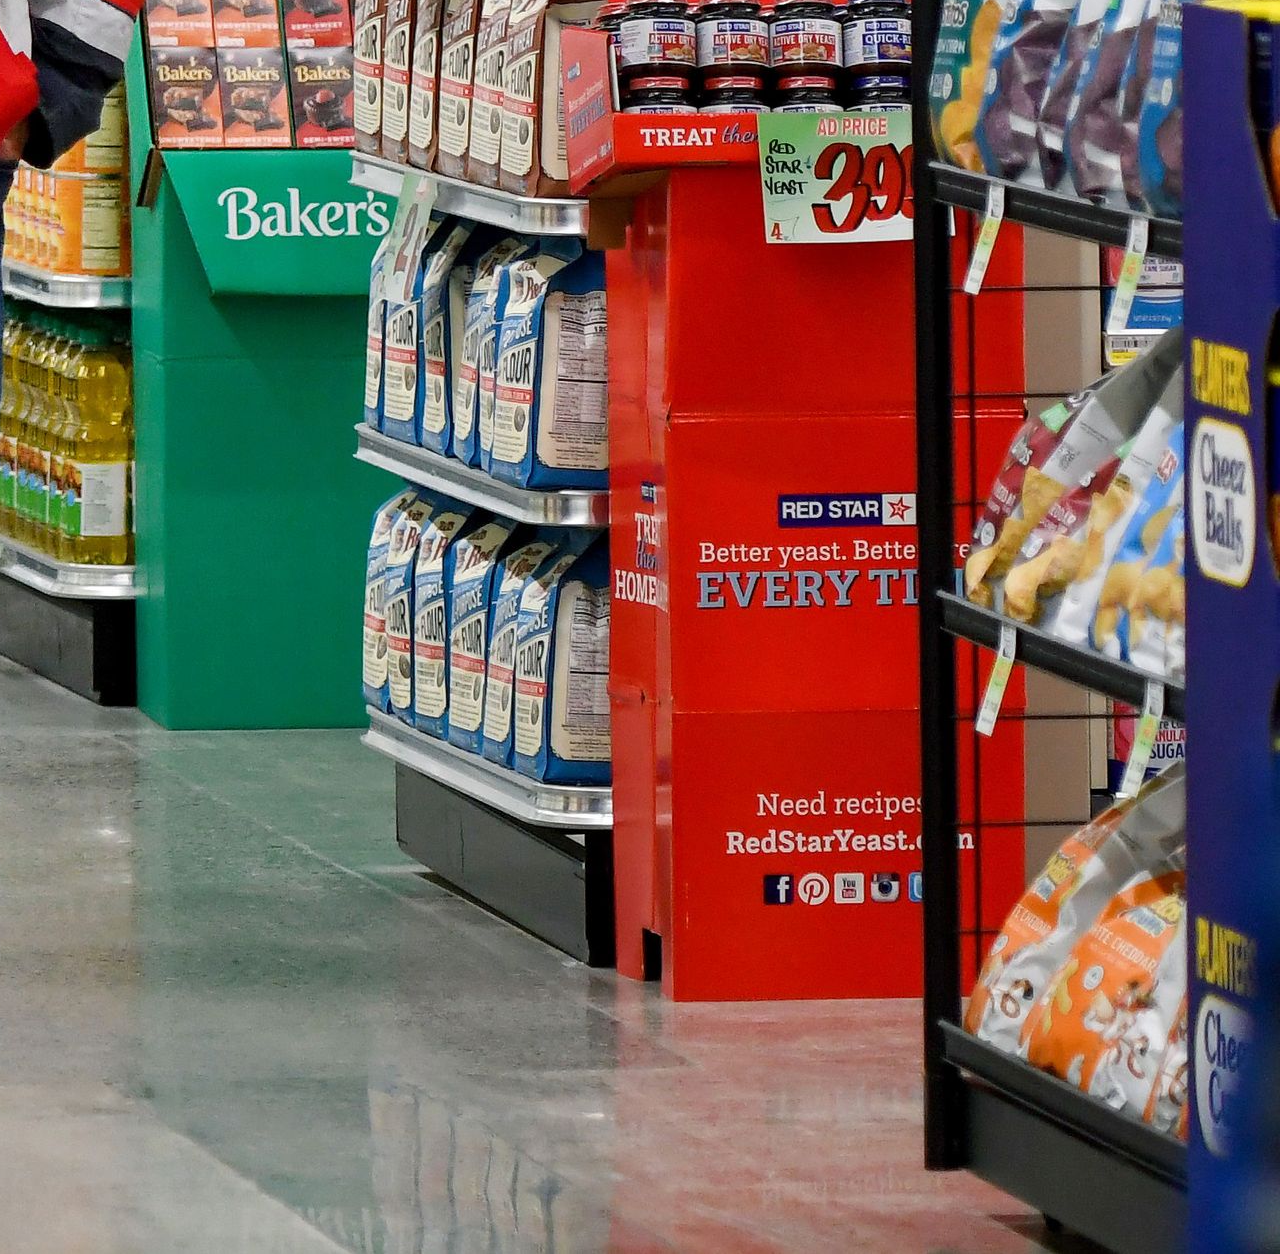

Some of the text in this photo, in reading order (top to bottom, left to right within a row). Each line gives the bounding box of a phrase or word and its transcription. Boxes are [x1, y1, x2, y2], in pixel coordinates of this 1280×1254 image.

[650, 34, 676, 45] ACTIVE
[157, 64, 213, 82] Baker's
[224, 65, 280, 83] Baker's
[294, 64, 351, 83] Baker's
[510, 59, 533, 98] FLOUR
[640, 127, 717, 147] TREAT
[817, 118, 888, 136] AD PRICE
[768, 139, 796, 155] RED
[765, 156, 804, 174] STAR
[764, 178, 809, 195] YEAST
[217, 186, 391, 241] Baker's
[392, 309, 414, 346] FLOUR
[502, 347, 532, 385] FLOUR
[1200, 432, 1248, 487] Cheez
[781, 499, 880, 519] RED STAR
[699, 542, 771, 564] Better
[779, 542, 847, 567] yeast.
[696, 568, 919, 609] EVERY TI
[420, 605, 444, 643] FLOUR
[461, 618, 483, 656] FLOUR
[519, 639, 545, 679] FLOUR
[756, 793, 827, 817] Need
[725, 830, 974, 855] RedStarYeast.cm
